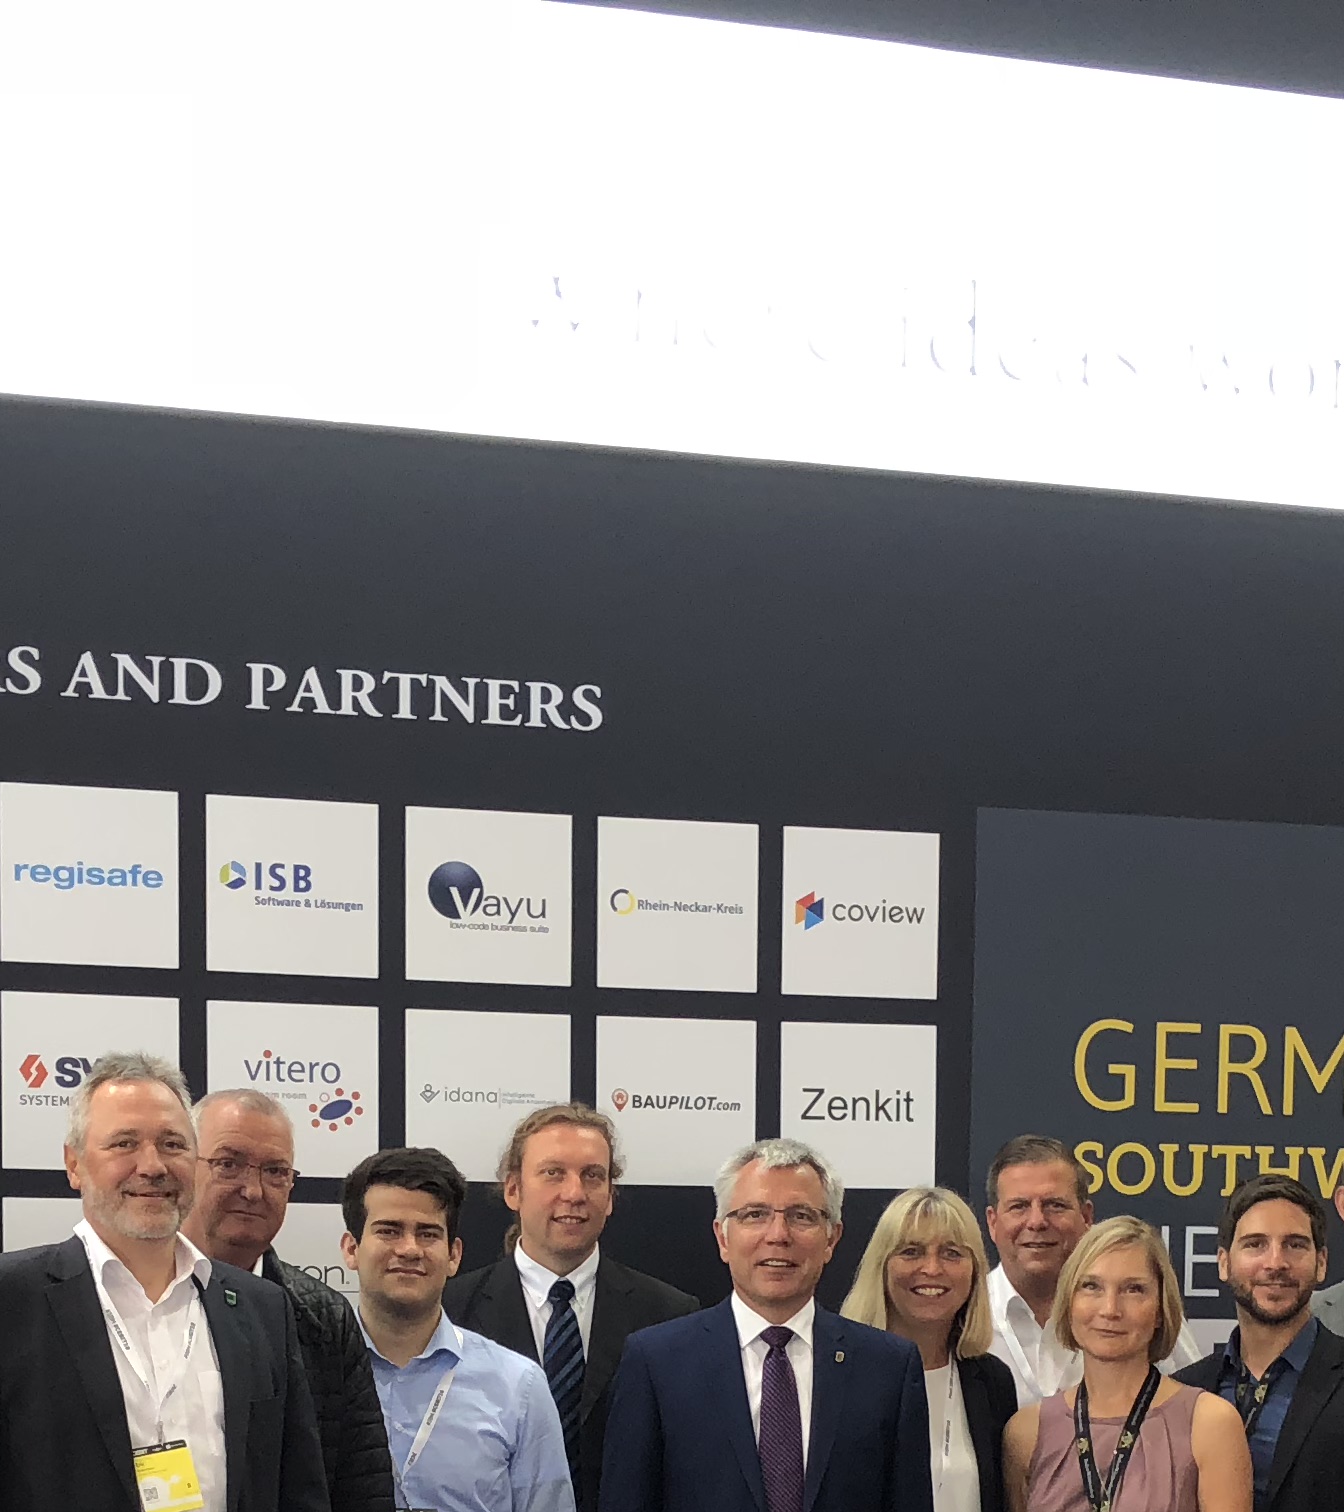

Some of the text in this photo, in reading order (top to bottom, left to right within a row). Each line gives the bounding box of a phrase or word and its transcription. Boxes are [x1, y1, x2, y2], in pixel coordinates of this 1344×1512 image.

[60, 650, 223, 706] AND
[244, 662, 604, 732] PARTNERS
[13, 861, 164, 890] regisafe
[254, 861, 313, 893] ISB
[254, 895, 364, 912] Software & Lösungen
[448, 886, 547, 925] Vayu
[637, 899, 745, 915] Rhein-Neckar-Kreis
[831, 898, 926, 925] coview
[243, 1049, 341, 1085] vitero
[443, 1086, 499, 1104] idana
[631, 1094, 742, 1113] BAUPILOT.com
[800, 1087, 915, 1123] Zenkit
